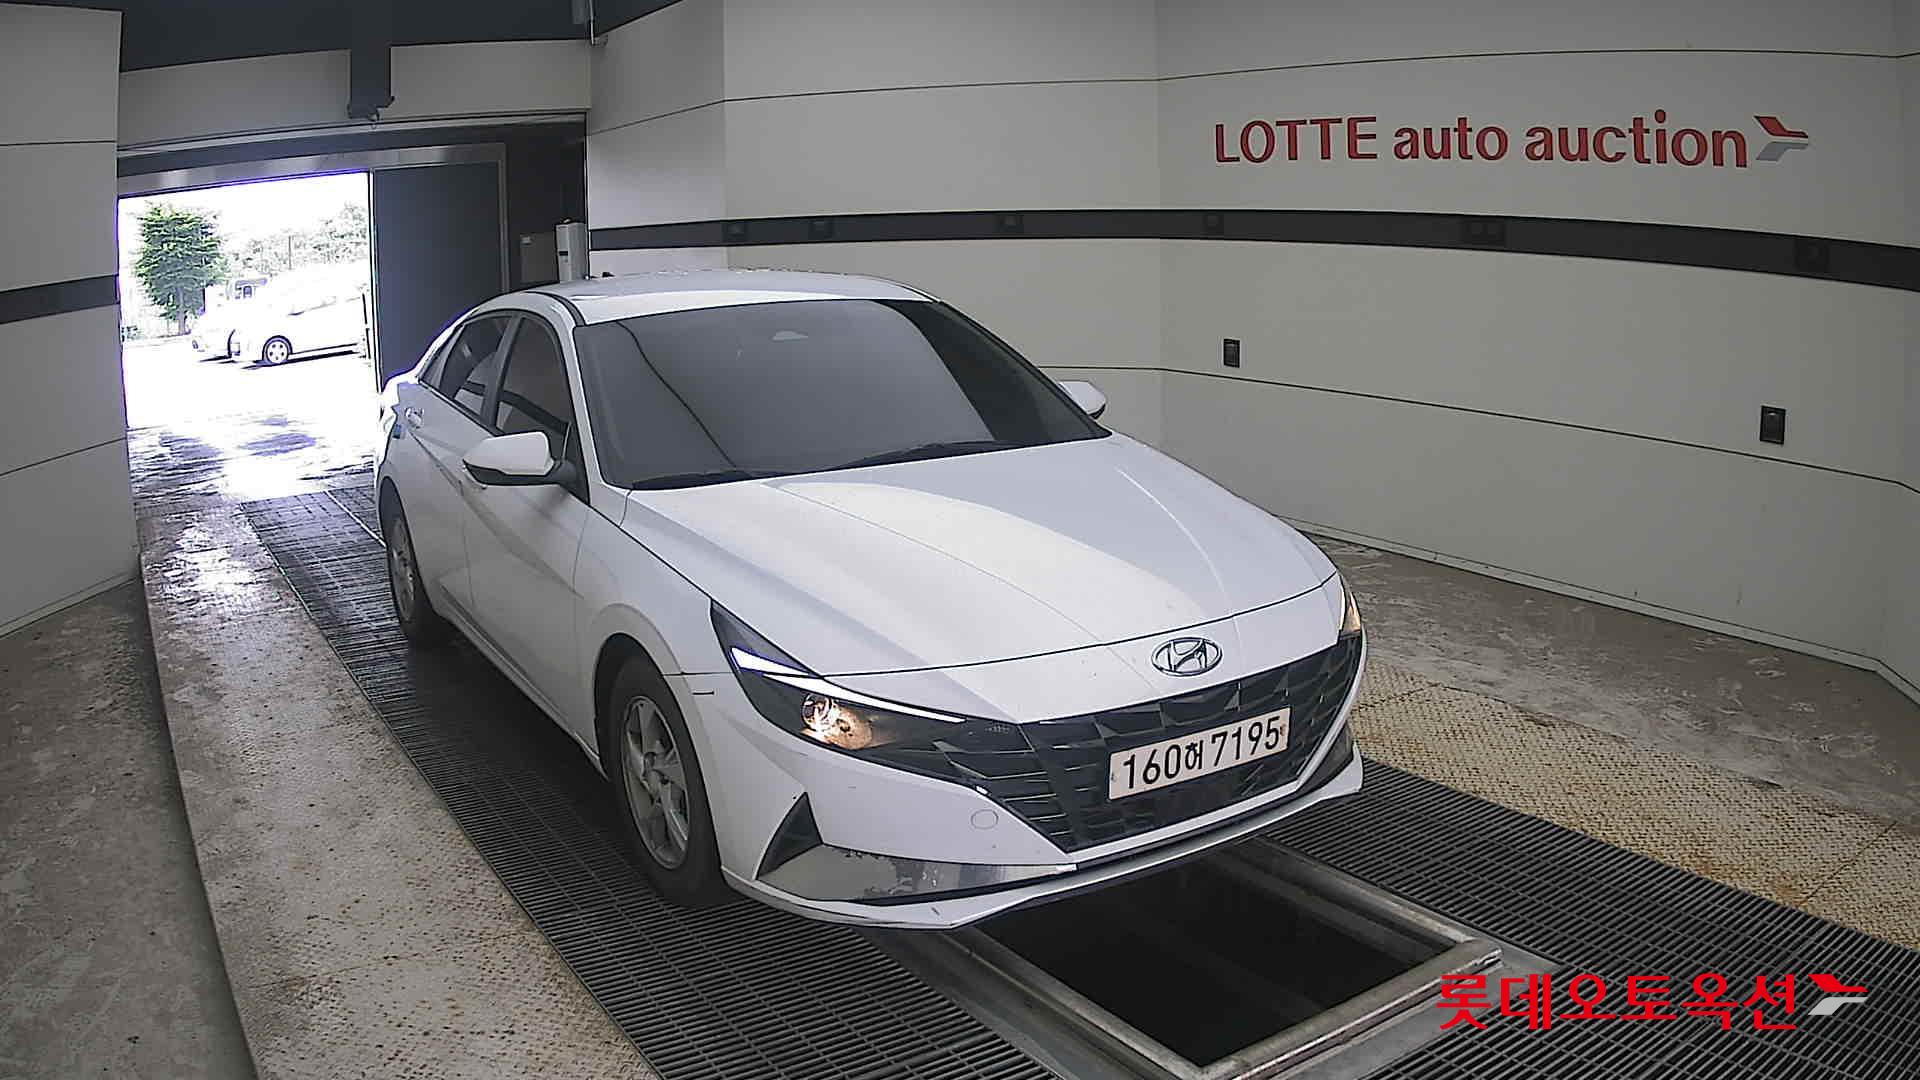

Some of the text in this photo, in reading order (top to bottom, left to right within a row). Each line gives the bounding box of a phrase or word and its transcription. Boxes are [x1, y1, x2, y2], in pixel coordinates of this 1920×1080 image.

[1215, 109, 1748, 168] LOTTE auto auction
[1123, 716, 1280, 789] 160허 7195
